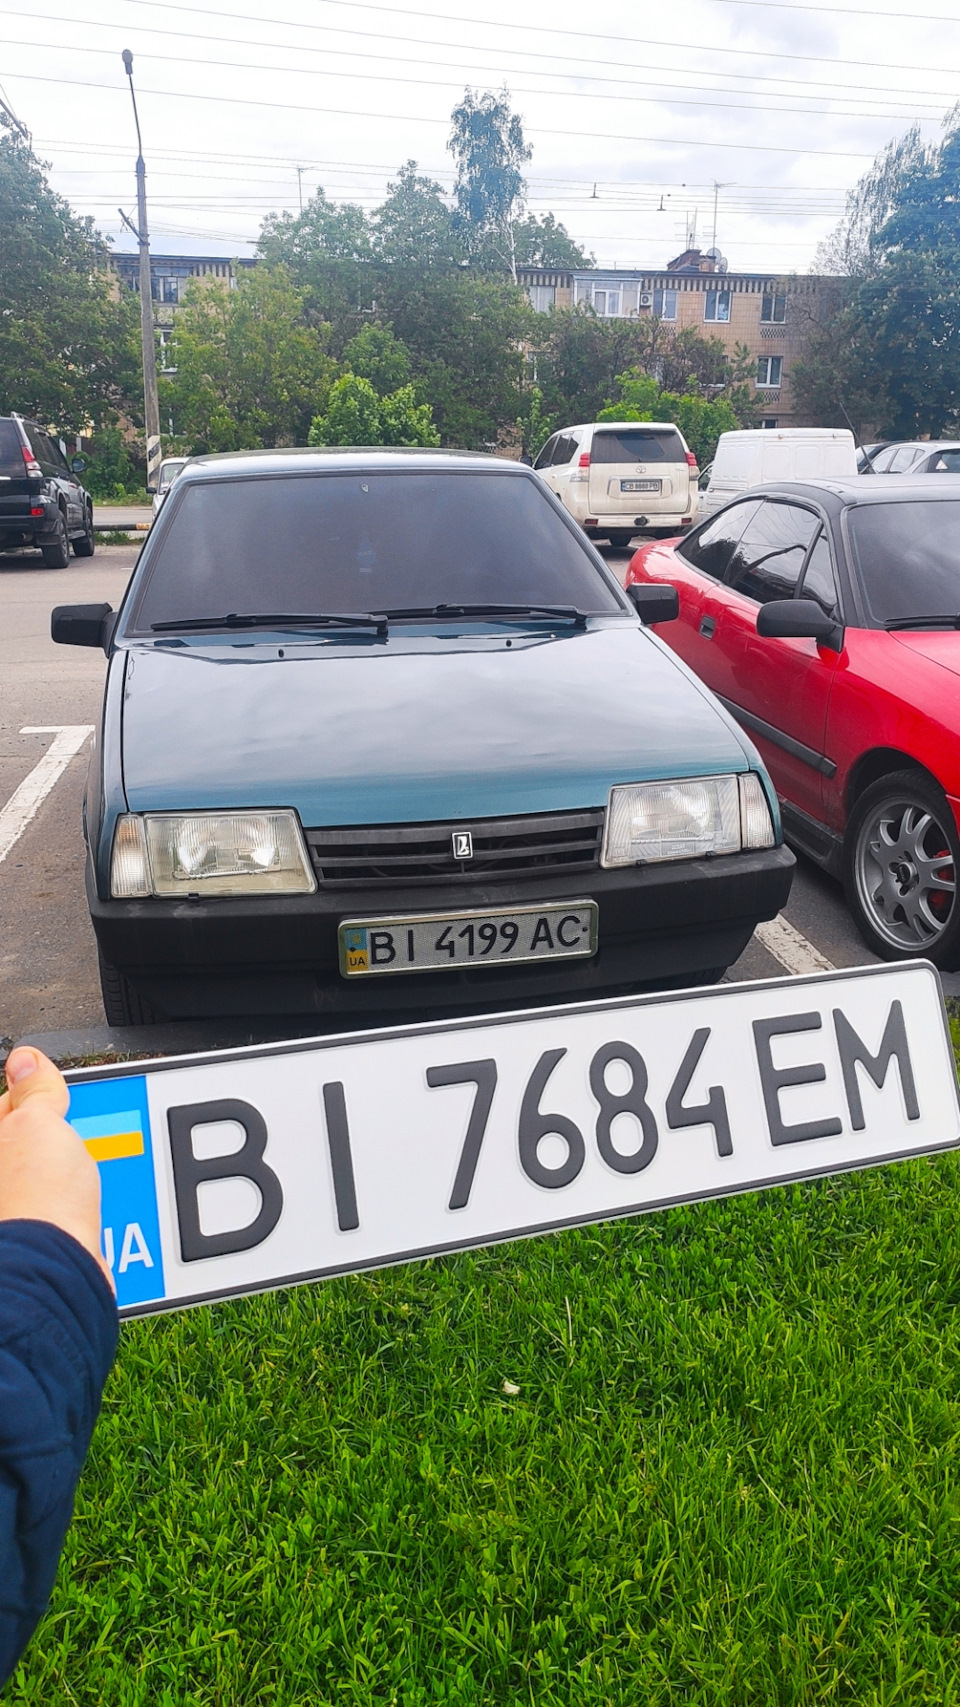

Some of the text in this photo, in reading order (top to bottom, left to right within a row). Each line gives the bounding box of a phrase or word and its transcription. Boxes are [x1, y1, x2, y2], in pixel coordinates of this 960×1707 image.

[349, 957, 366, 967] UA
[370, 915, 581, 965] BI 4199 AC
[167, 999, 920, 1262] BI 7684 EM
